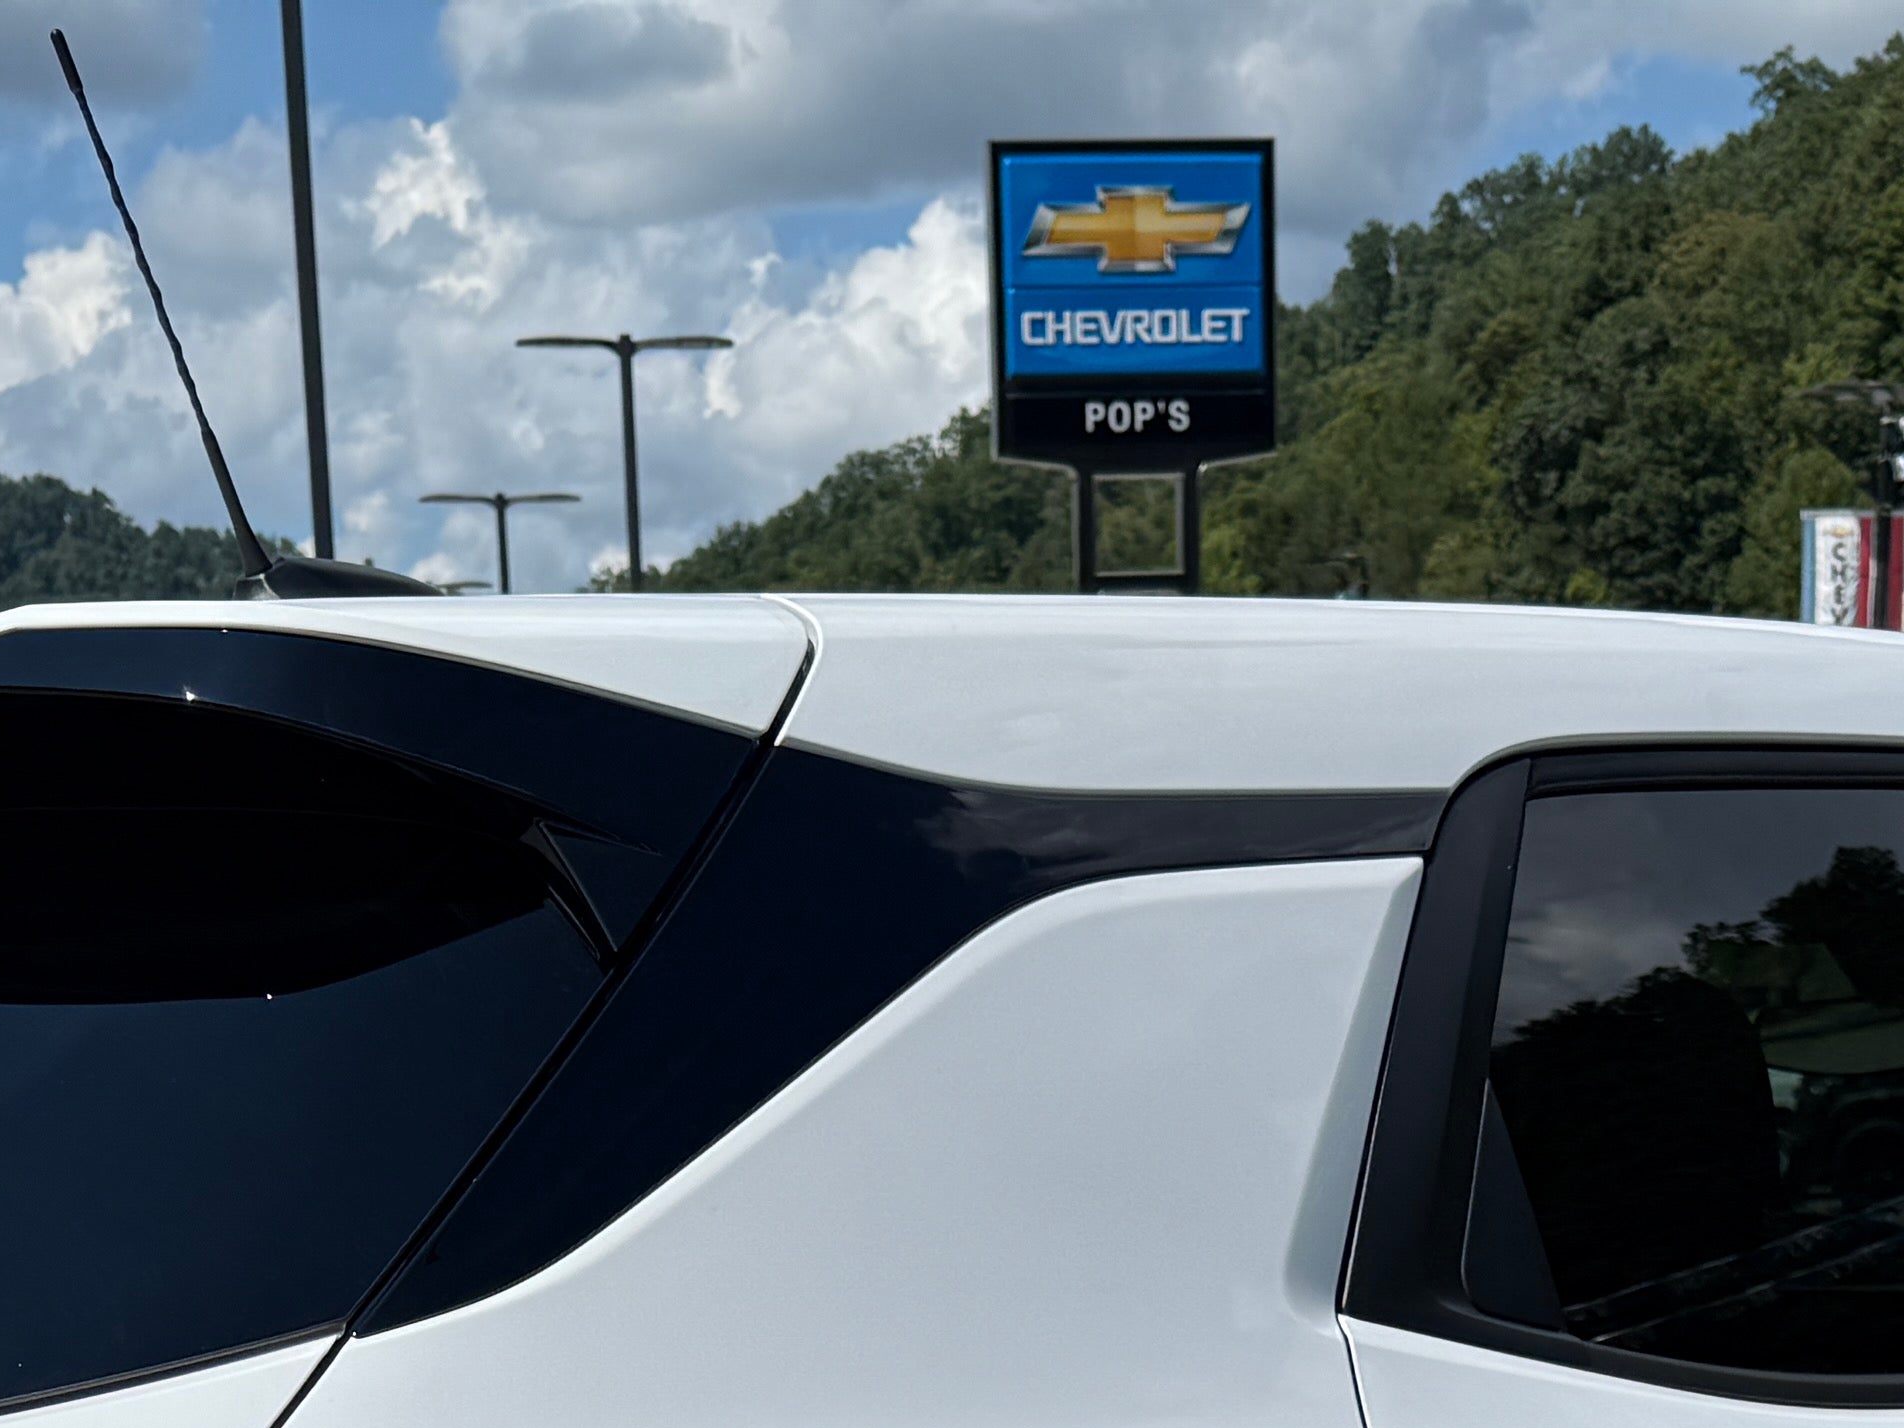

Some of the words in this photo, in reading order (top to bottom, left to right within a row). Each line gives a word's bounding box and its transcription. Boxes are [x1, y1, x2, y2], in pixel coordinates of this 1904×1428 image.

[1020, 307, 1251, 347] CHEVROLET
[1084, 398, 1192, 434] POP'S
[1829, 541, 1850, 626] CHEV
